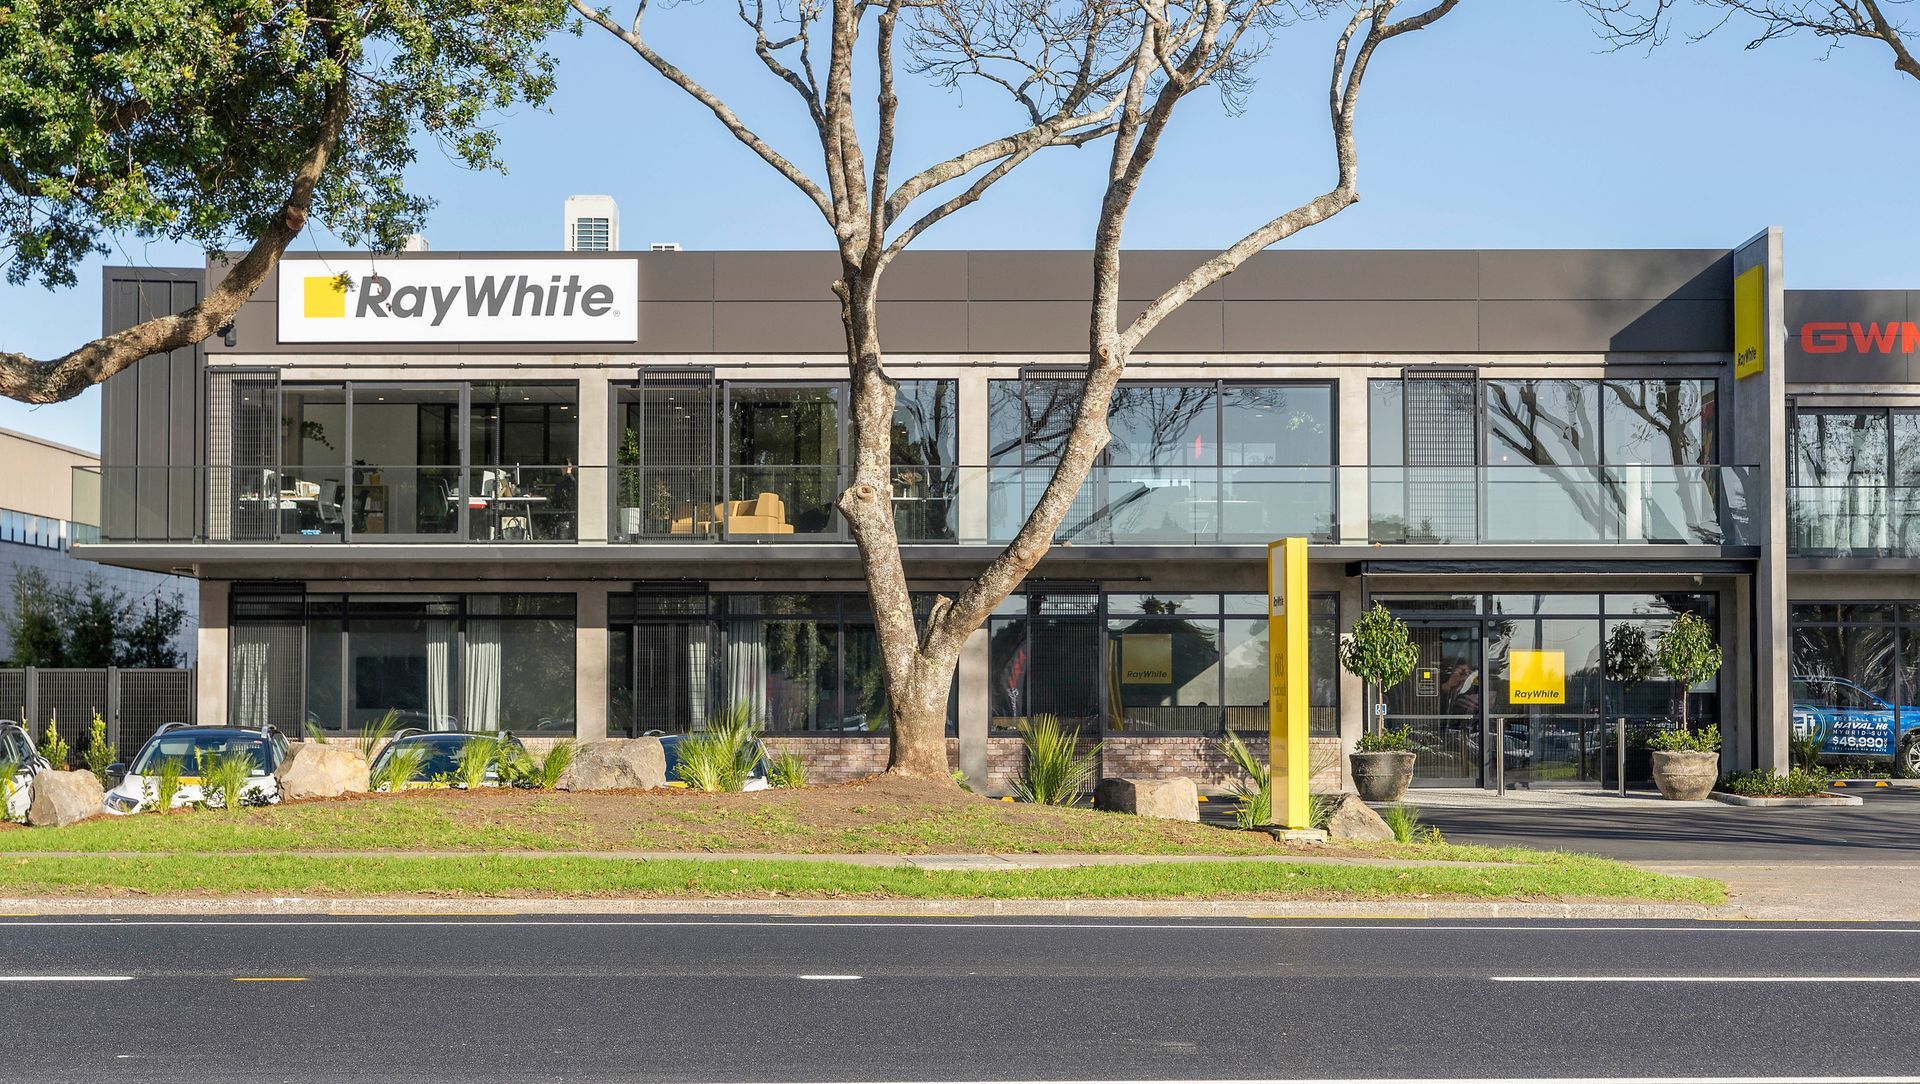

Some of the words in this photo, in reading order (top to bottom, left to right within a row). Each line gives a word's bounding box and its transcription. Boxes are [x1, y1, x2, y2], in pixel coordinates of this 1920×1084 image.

[1833, 721, 1874, 730] HAVAL
[1875, 722, 1888, 730] H6
[1832, 735, 1883, 748] $46,990
